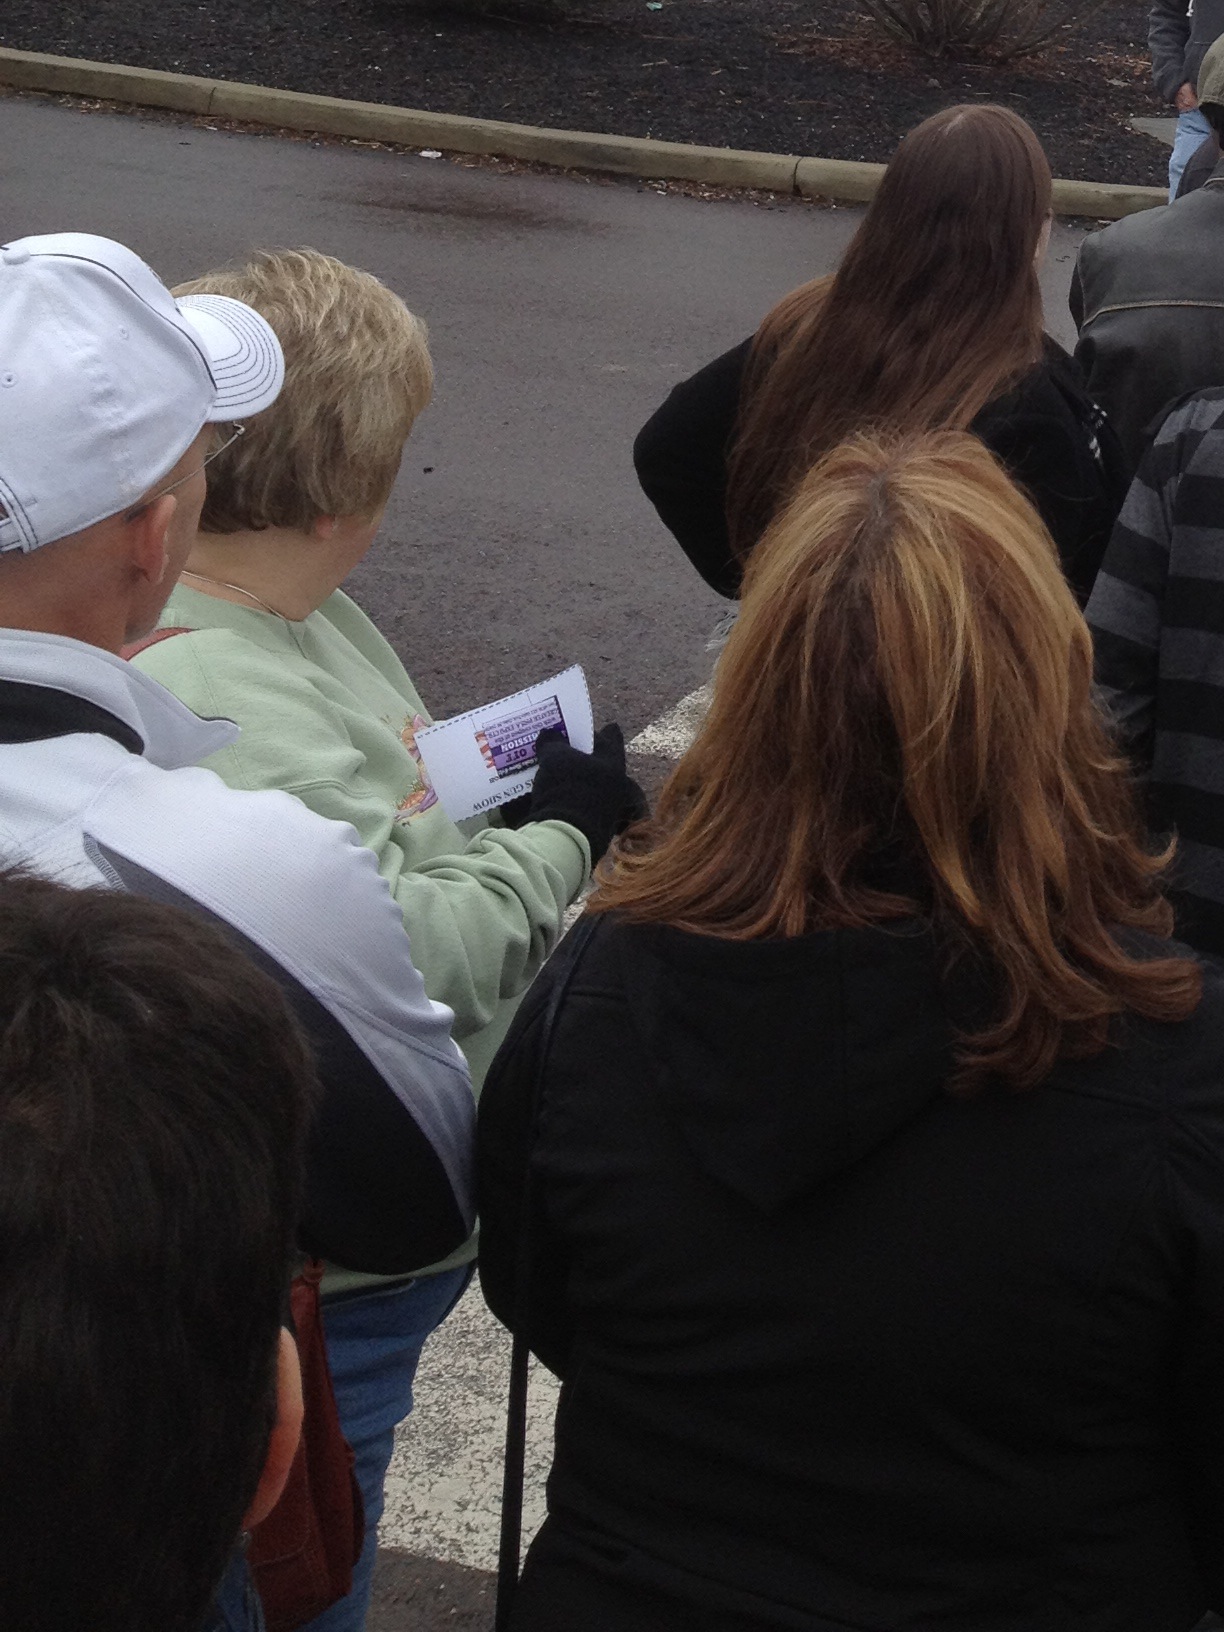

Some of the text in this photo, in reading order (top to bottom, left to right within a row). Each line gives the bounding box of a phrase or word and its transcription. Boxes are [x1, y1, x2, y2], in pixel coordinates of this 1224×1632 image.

[505, 748, 528, 763] OFF
[473, 784, 524, 811] GUN SHOW
